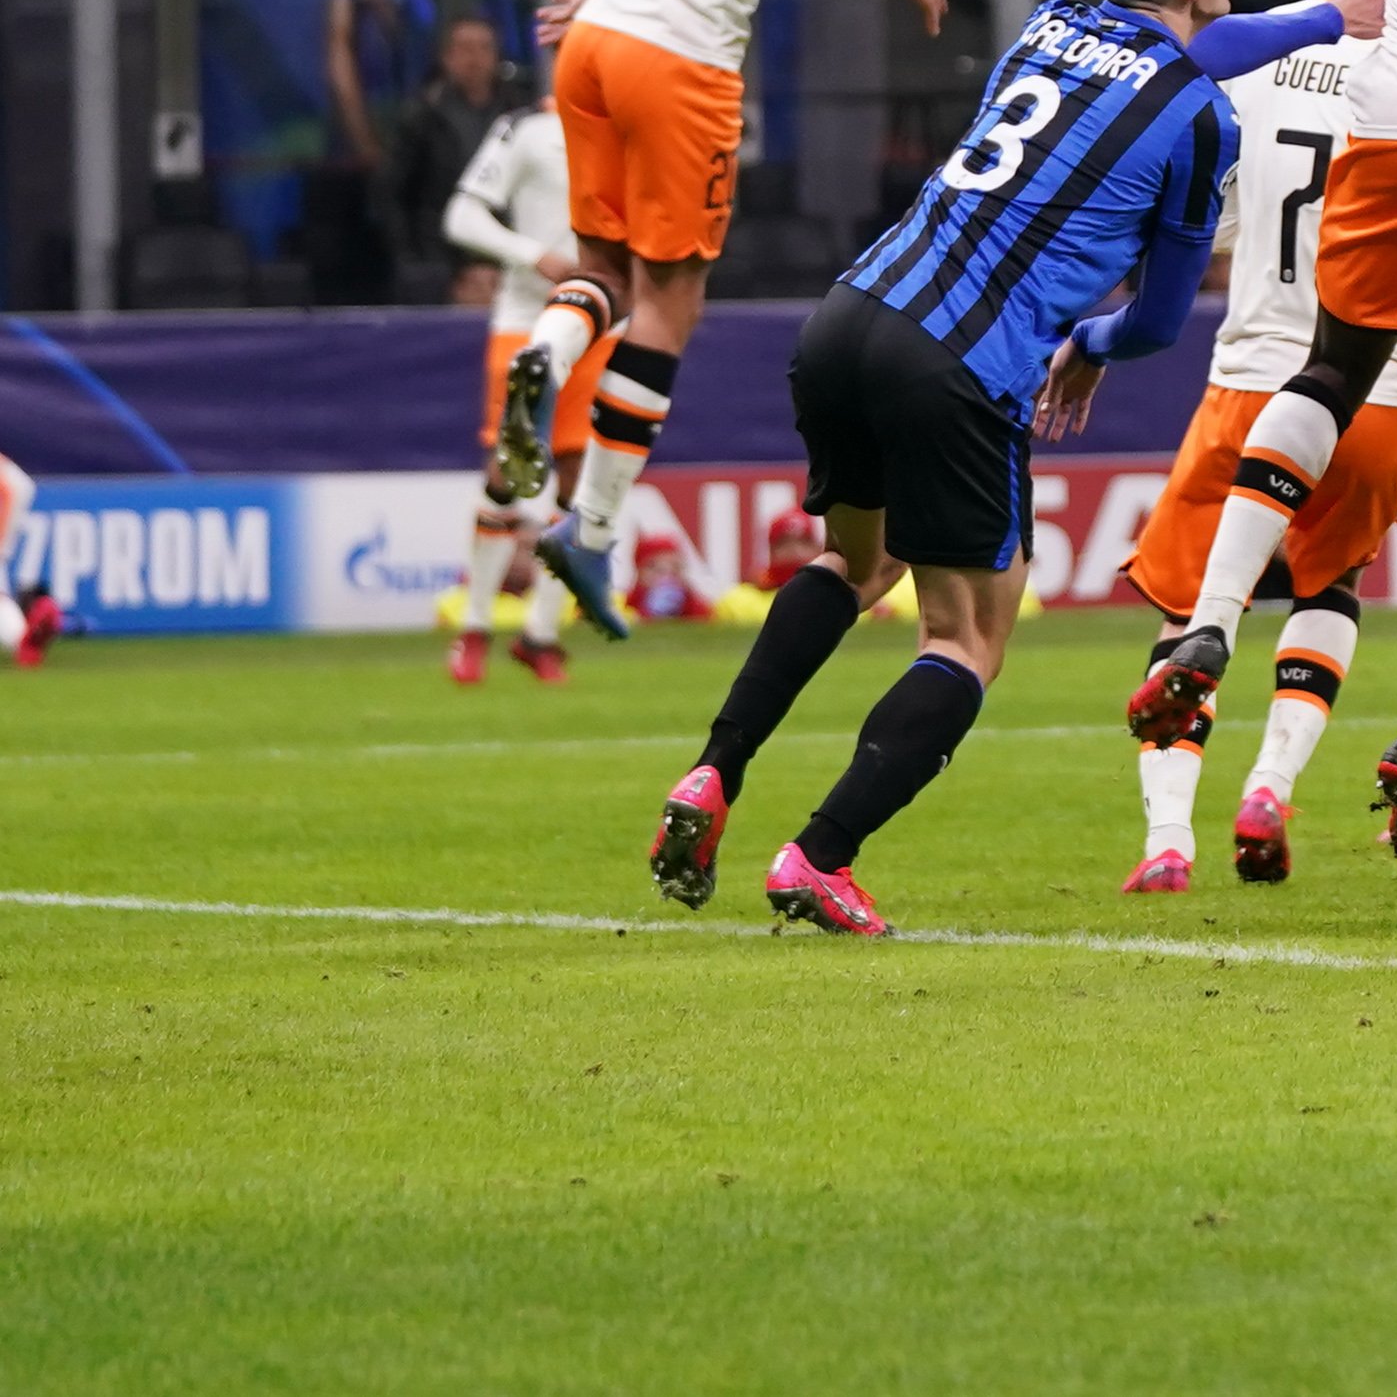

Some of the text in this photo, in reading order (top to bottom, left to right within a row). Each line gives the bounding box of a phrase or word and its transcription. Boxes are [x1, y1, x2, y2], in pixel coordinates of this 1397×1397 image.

[1020, 11, 1159, 91] CALDARA
[1273, 56, 1349, 96] GUEDE
[942, 74, 1062, 193] 3
[1276, 129, 1334, 283] 7
[1268, 473, 1302, 499] VCF
[17, 506, 271, 609] ZPROM
[1280, 667, 1314, 682] VCF
